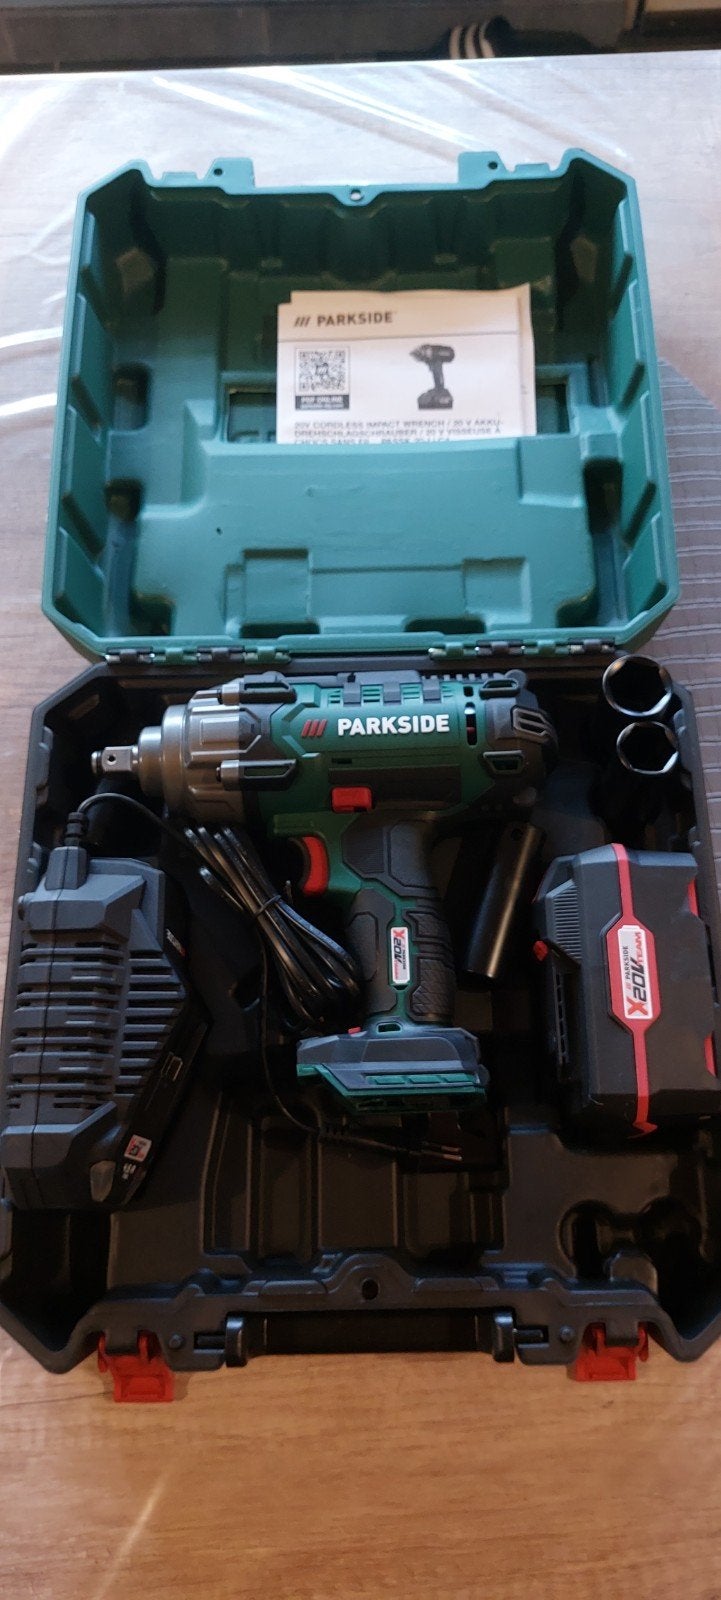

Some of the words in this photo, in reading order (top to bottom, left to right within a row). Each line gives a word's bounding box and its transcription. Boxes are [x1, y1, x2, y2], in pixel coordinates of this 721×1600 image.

[317, 312, 393, 326] PARKSIDE
[313, 421, 364, 430] CORDLESS
[366, 420, 400, 428] IMPACT
[404, 419, 445, 428] WRENCH
[338, 714, 450, 736] PARKSIDE
[622, 945, 631, 980] PARKSIDE
